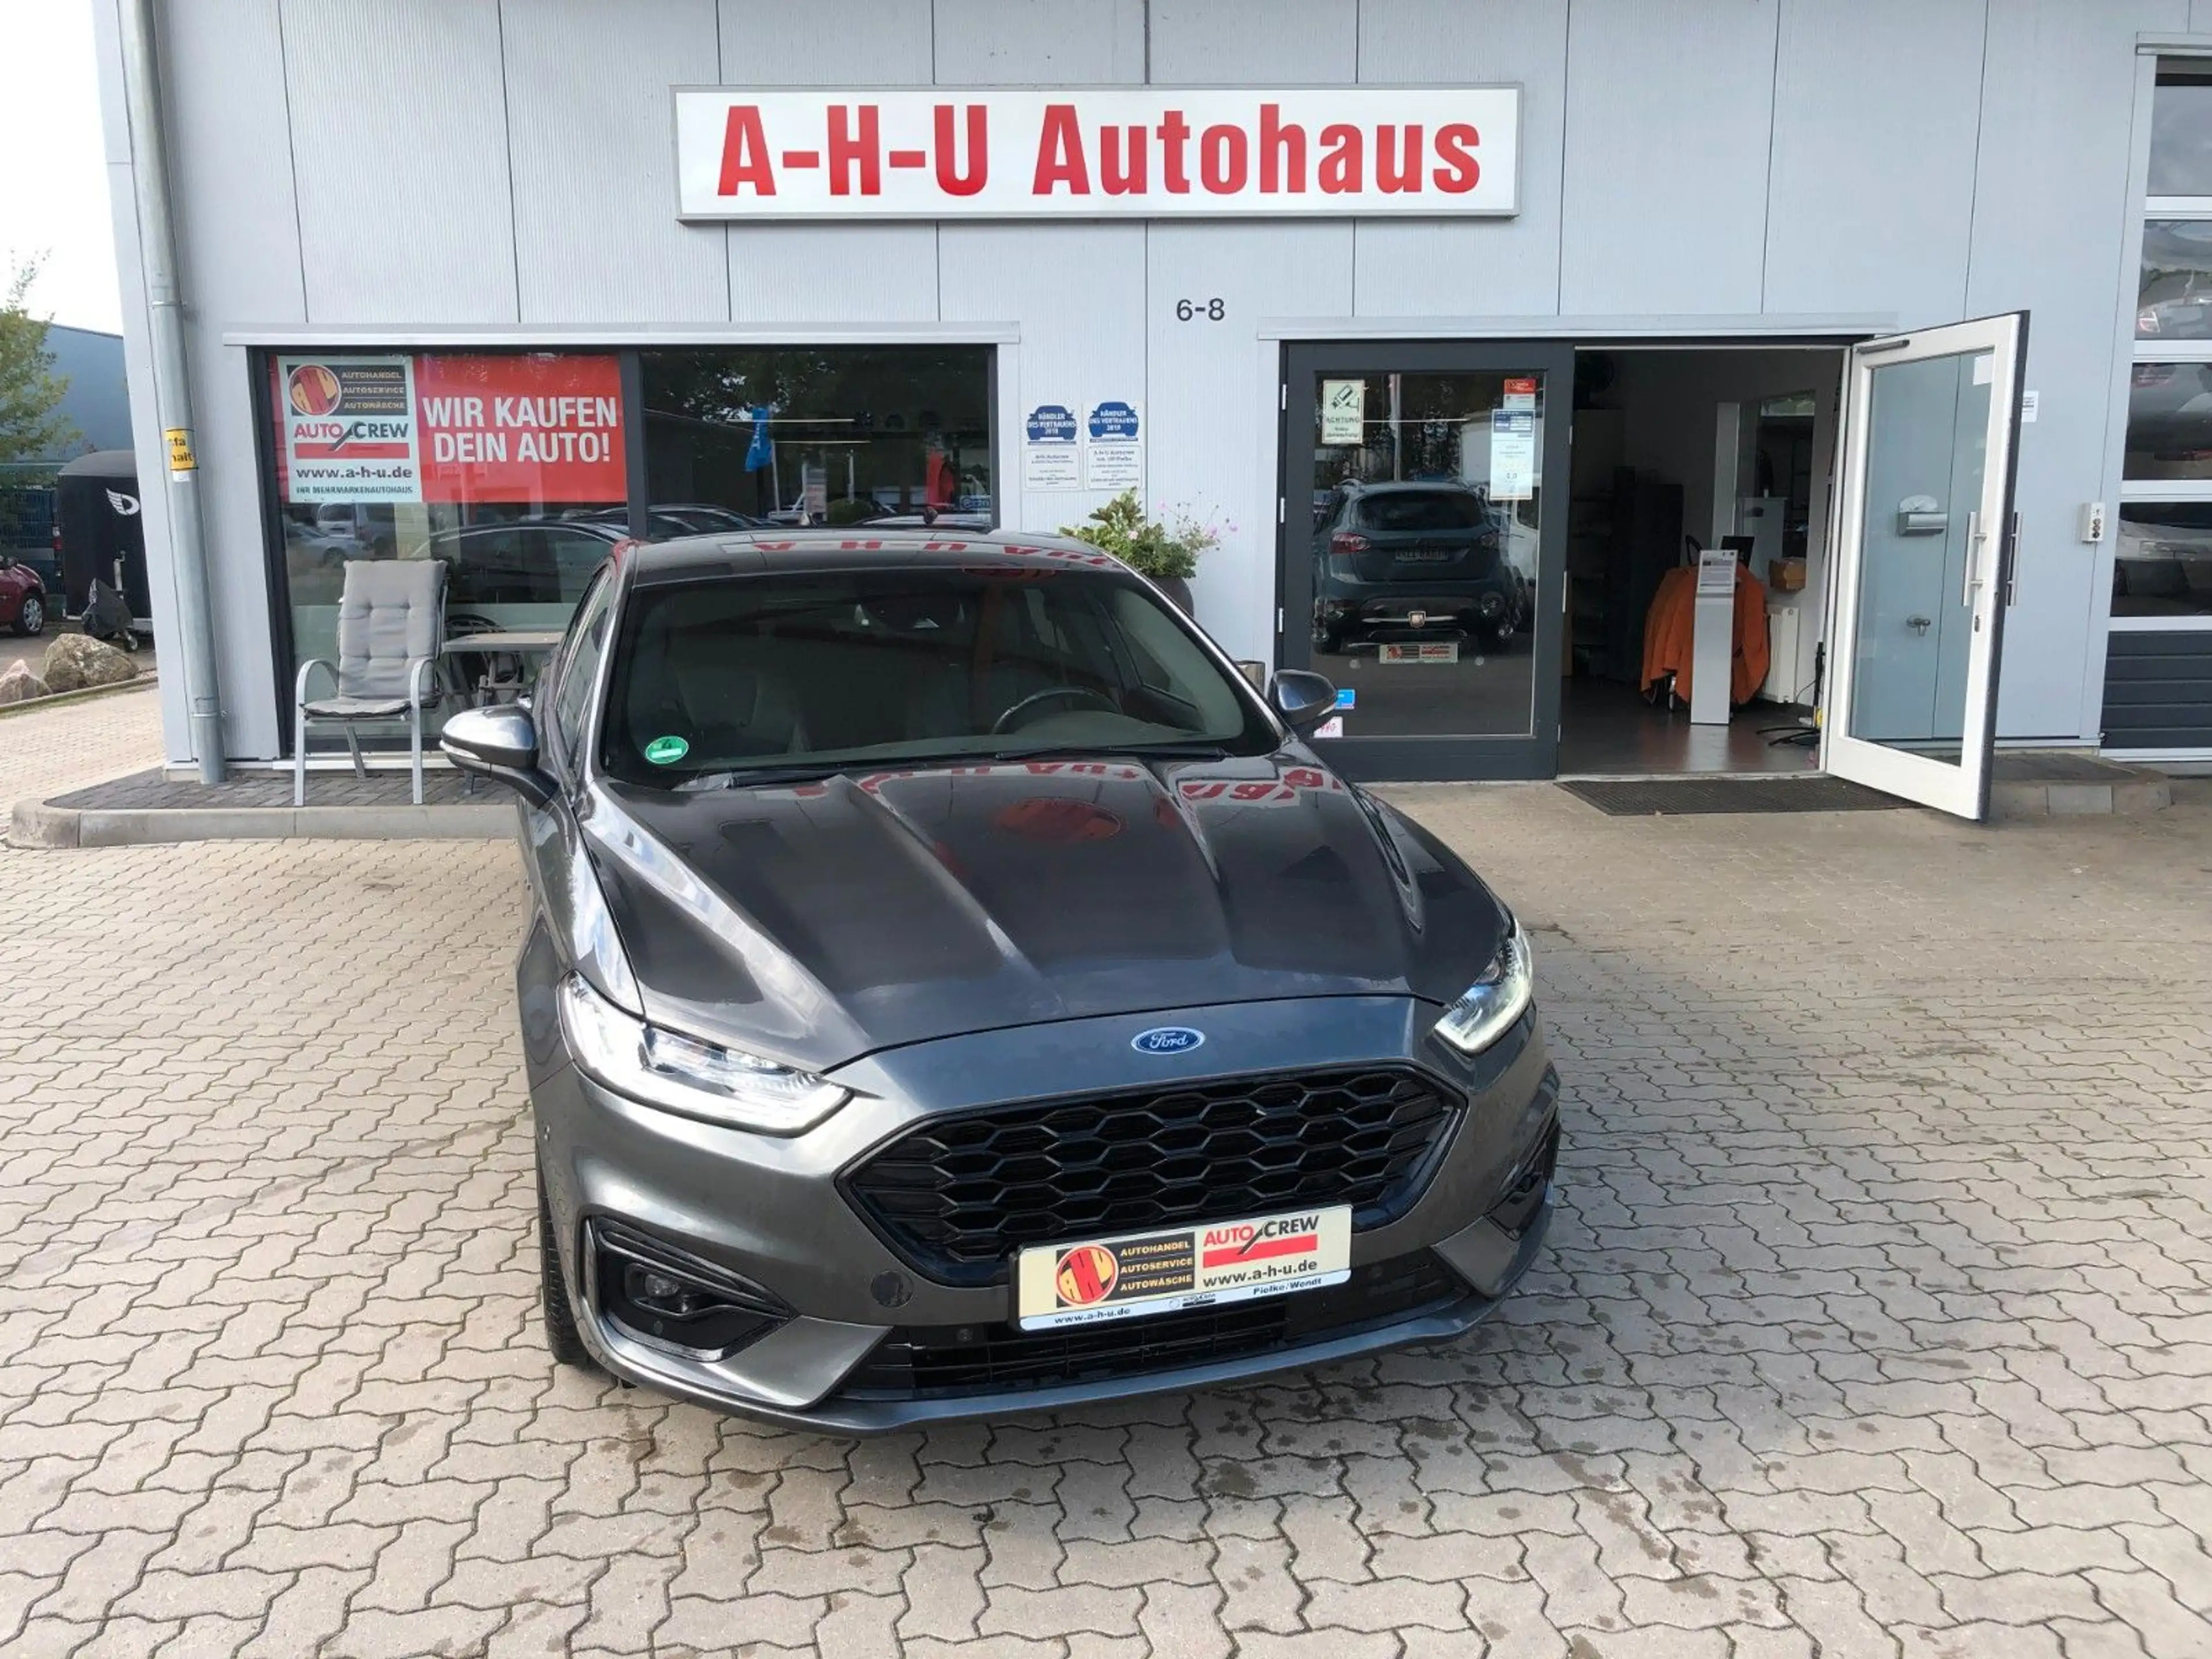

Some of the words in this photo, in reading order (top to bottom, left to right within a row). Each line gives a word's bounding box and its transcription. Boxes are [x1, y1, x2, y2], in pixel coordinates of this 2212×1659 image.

[717, 105, 988, 197] A-H-U
[1032, 104, 1480, 195] Autohaus
[1177, 298, 1224, 321] 6-8
[422, 396, 484, 427] WIR
[494, 396, 618, 427] KAUFEN
[434, 432, 507, 463] DEIN
[517, 432, 610, 463] AUTO!
[296, 466, 413, 478] www.a-h-u.de
[296, 486, 310, 494] IHR
[312, 486, 413, 494] MEHRMARKENAUTOHAUS
[1149, 1032, 1188, 1049] Ford
[1203, 1225, 1255, 1248] AUTO
[1262, 1215, 1320, 1238] CREW
[1120, 1240, 1191, 1257] AUTOHANDEL
[1120, 1257, 1194, 1274] AUTOSERVICE
[1203, 1259, 1318, 1288] www.a-h-u.de
[1120, 1274, 1193, 1291] AUTOWÄSCHE
[1054, 1307, 1131, 1325] www.a-h-u.de
